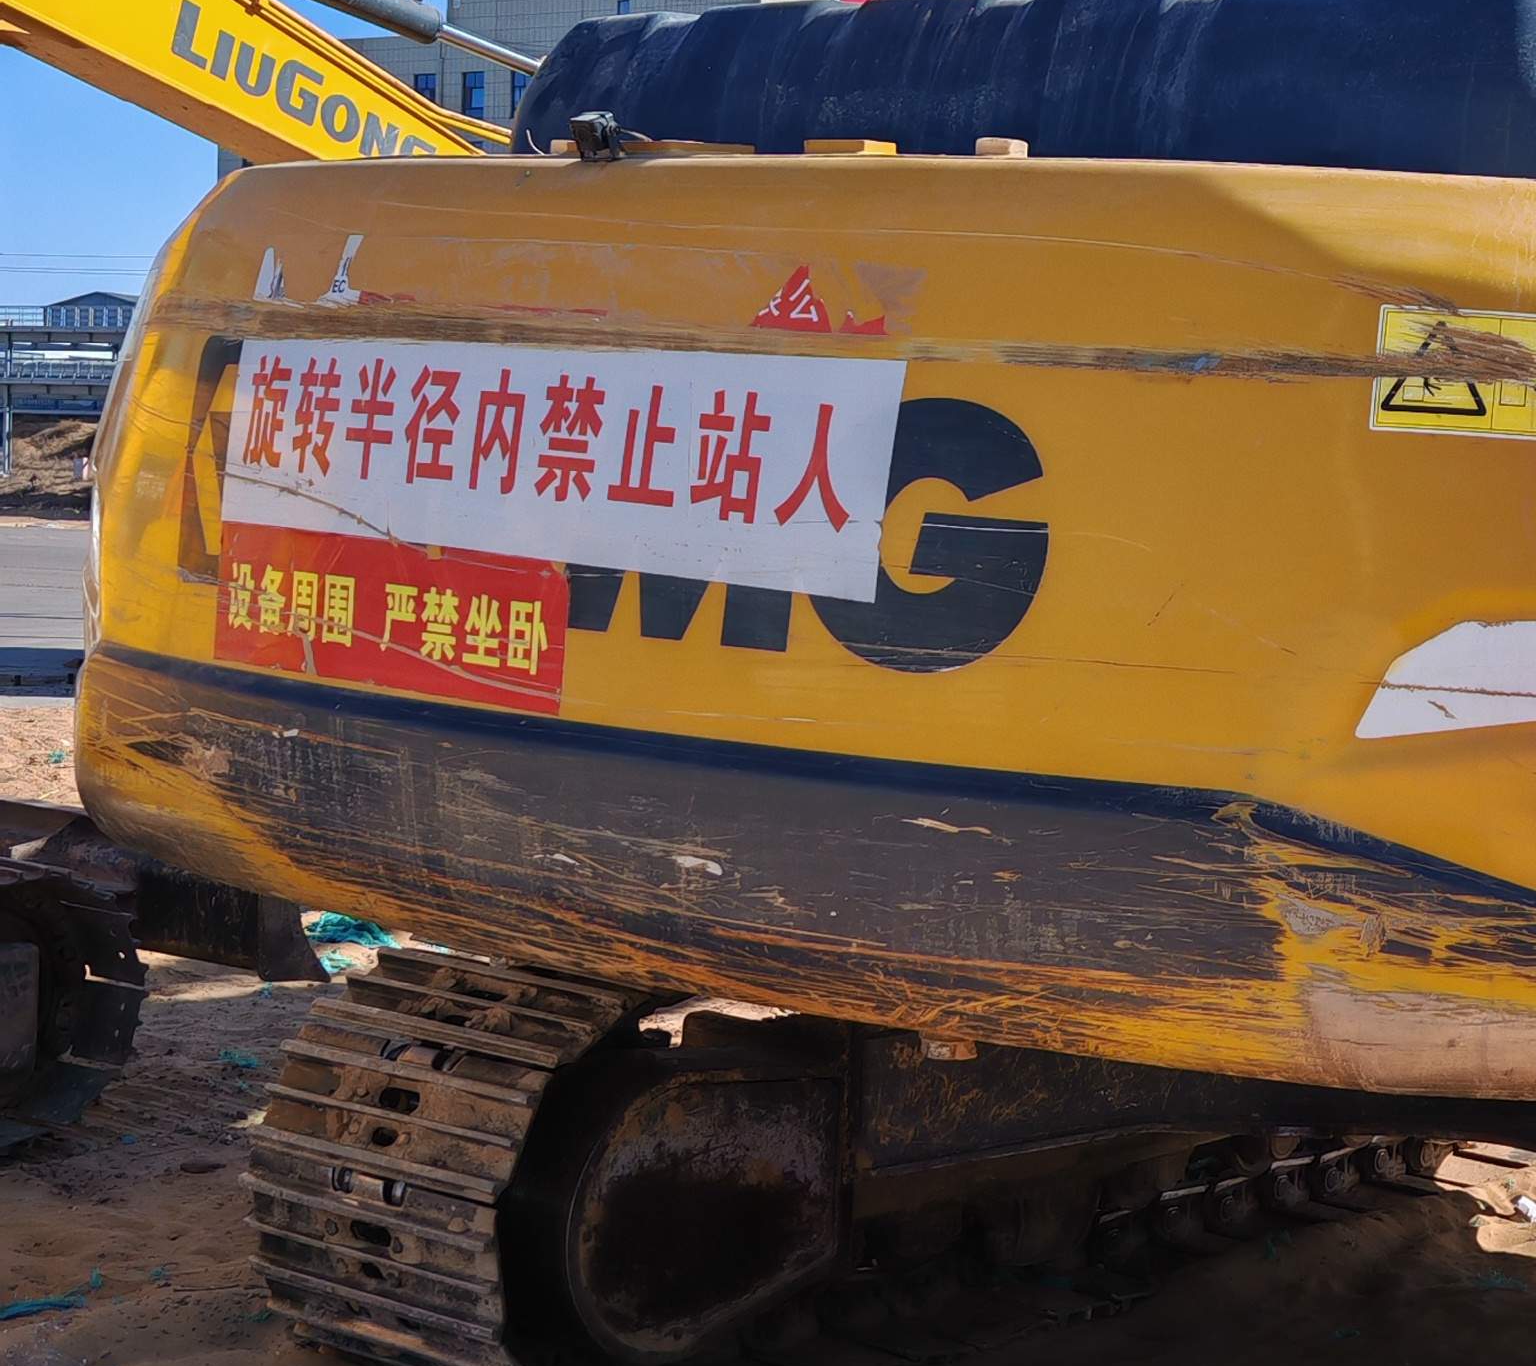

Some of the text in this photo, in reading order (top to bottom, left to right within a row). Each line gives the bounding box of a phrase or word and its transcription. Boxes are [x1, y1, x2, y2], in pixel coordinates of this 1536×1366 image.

[242, 354, 850, 533] 旋转半径内禁止站人
[226, 561, 549, 675] 设备周围 严禁坐卧
